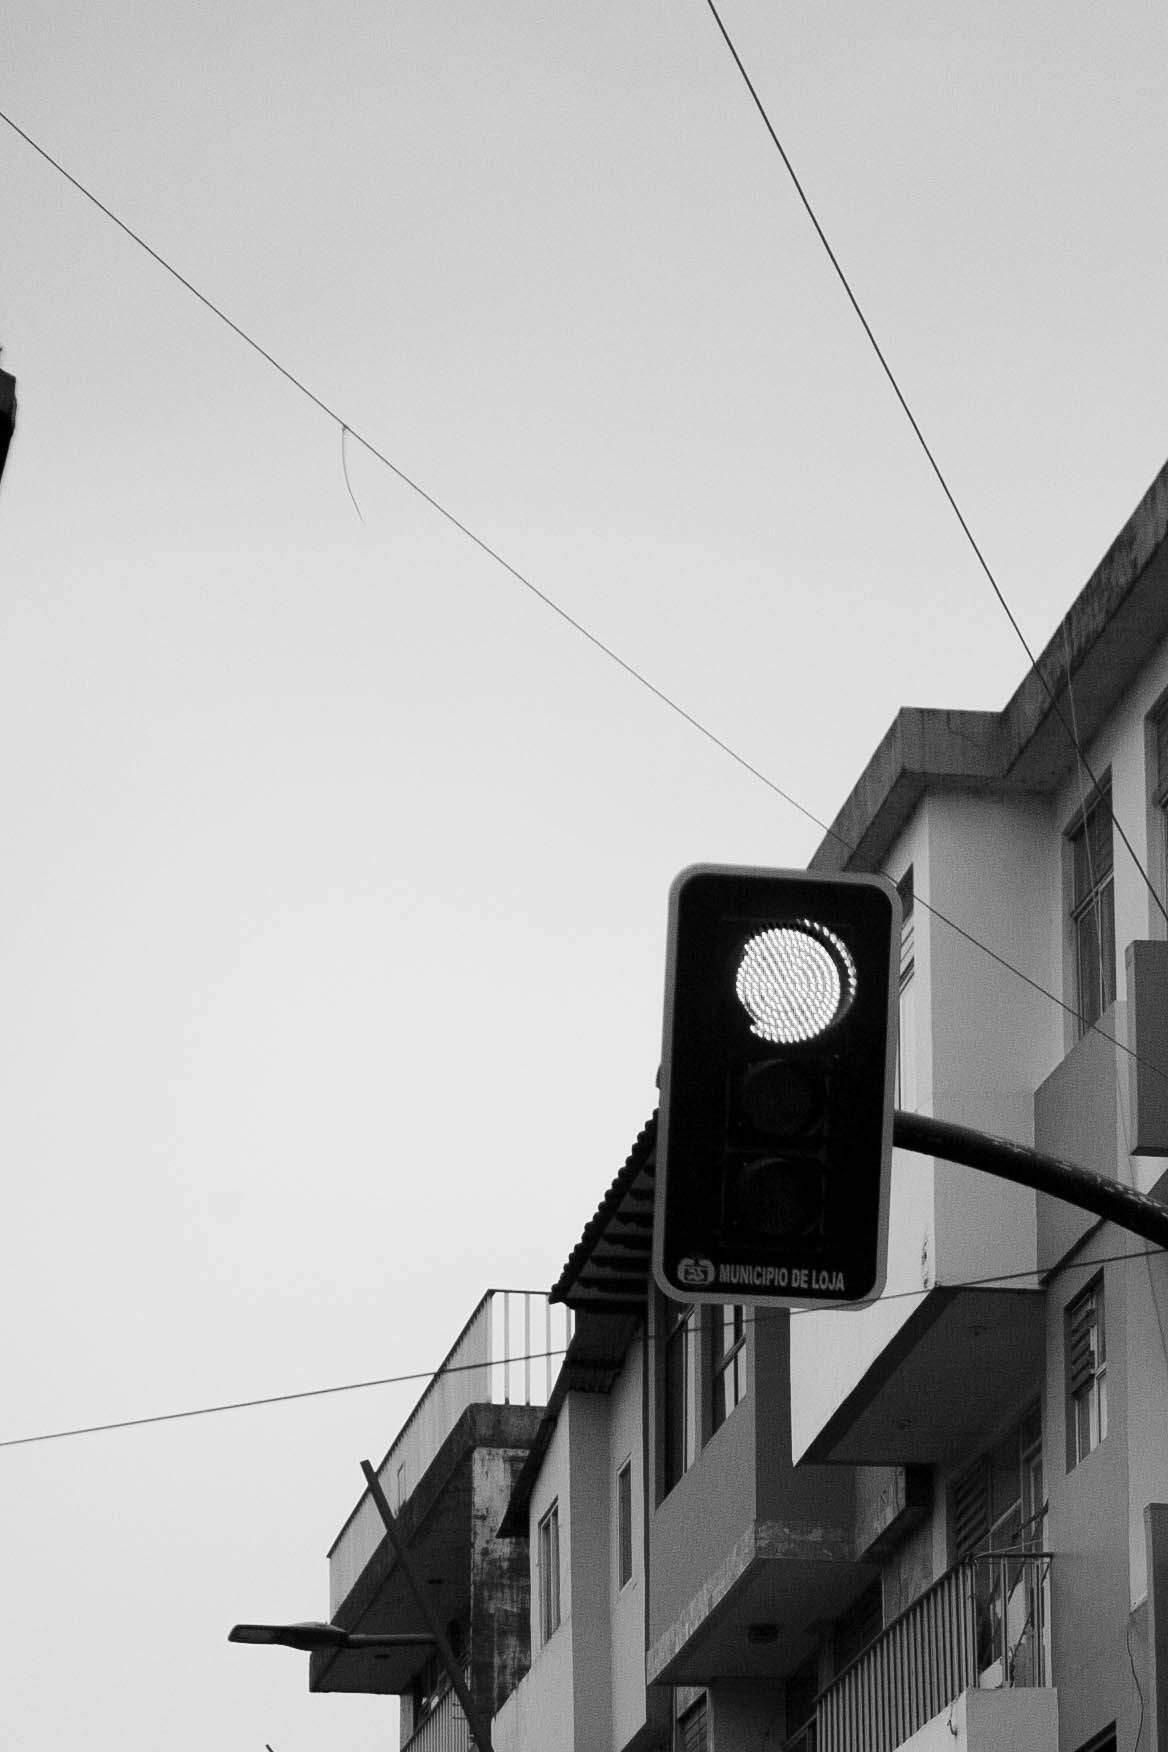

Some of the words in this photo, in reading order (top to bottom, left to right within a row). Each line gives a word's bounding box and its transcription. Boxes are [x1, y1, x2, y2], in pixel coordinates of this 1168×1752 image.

[719, 1263, 788, 1286] MUNICIPIO
[791, 1268, 808, 1288] DE
[811, 1269, 846, 1291] LOJA
